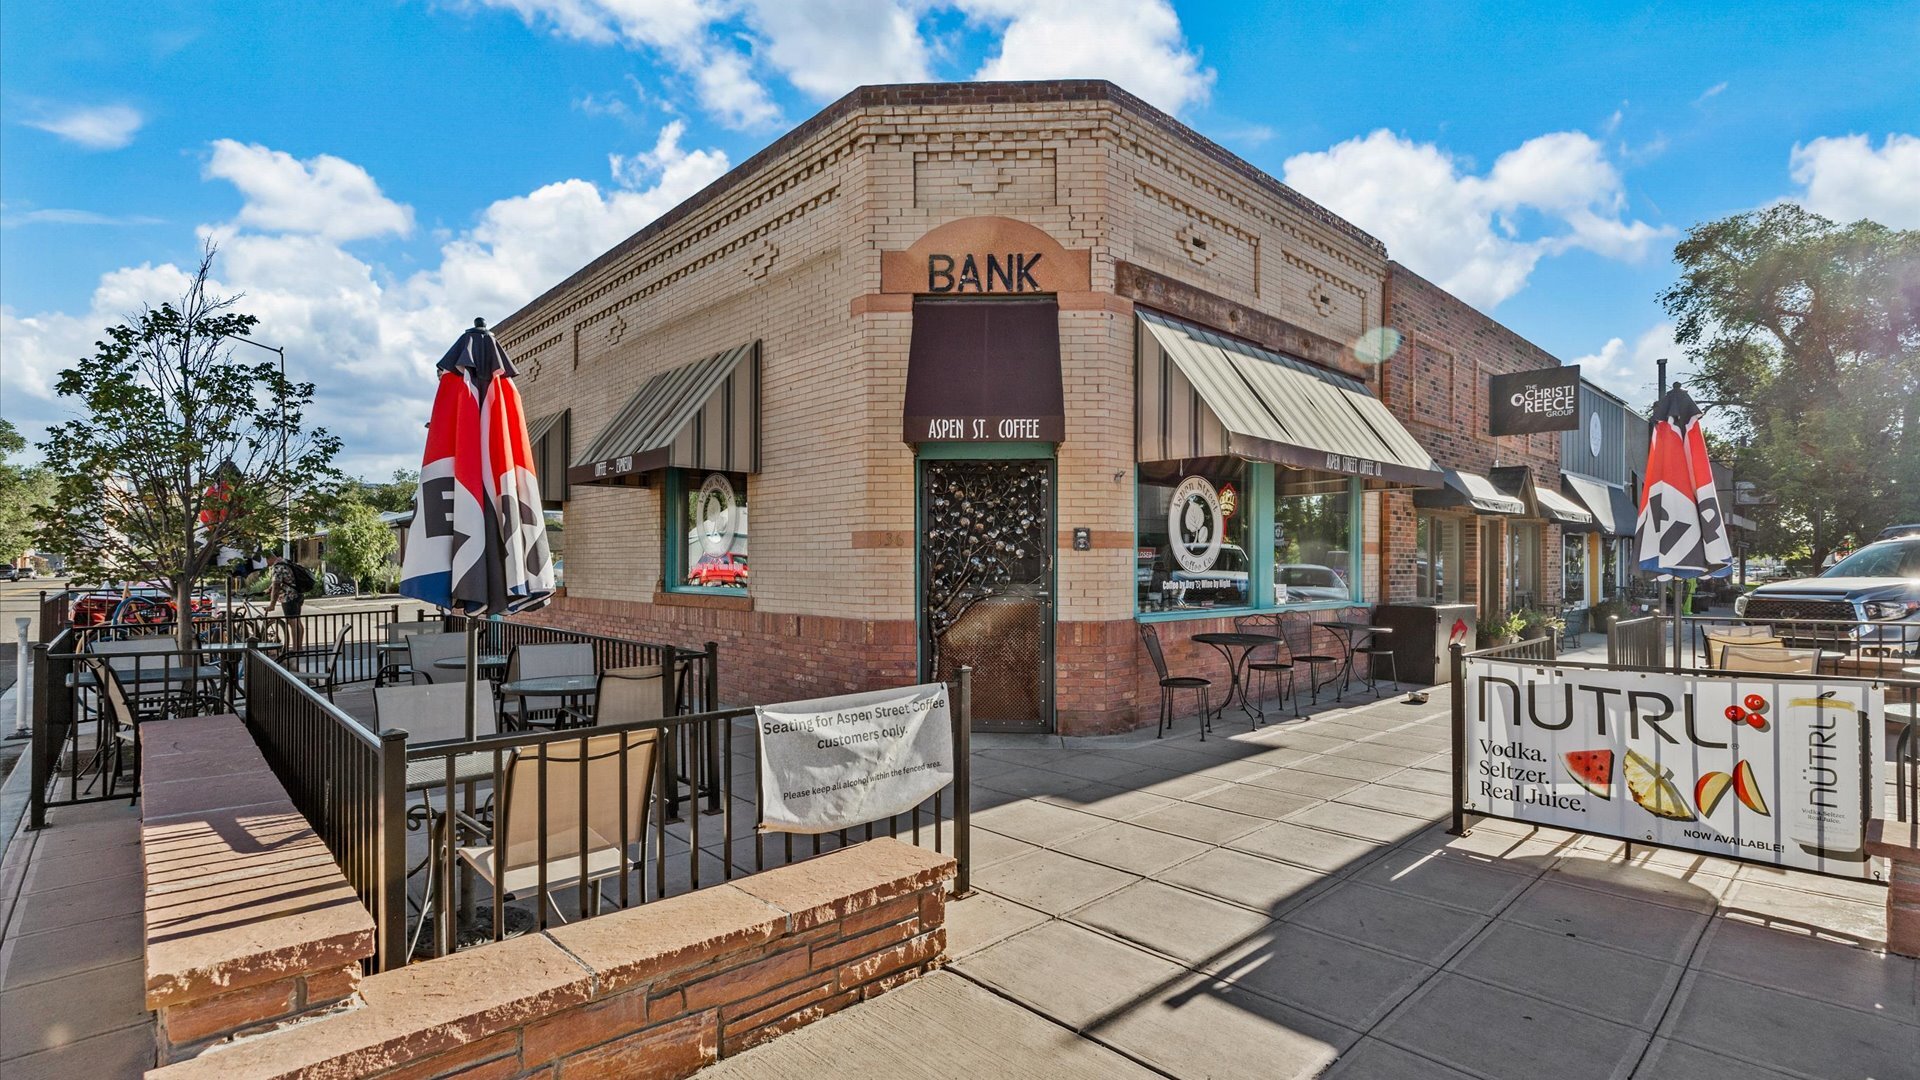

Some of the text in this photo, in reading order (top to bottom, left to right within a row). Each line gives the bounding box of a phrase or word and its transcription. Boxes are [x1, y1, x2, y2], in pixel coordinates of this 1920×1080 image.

[928, 253, 1043, 293] BANK
[1524, 385, 1574, 400] CHRISTI
[1524, 396, 1574, 413] REECE
[1546, 409, 1574, 417] GROUP
[928, 419, 1040, 439] ASPEN ST. COFFEE
[1359, 459, 1374, 475] COFFEE
[763, 698, 945, 735] Seating for Aspen Street Coffee
[817, 724, 908, 749] customers only.
[1479, 738, 1548, 763] Vodka.
[783, 760, 942, 801] Please keep all alcohol within the fenced area.
[1479, 759, 1551, 785] Seltzer.
[1480, 780, 1587, 813] Real Juice.
[1683, 829, 1785, 853] NOW AVAILABLE!
